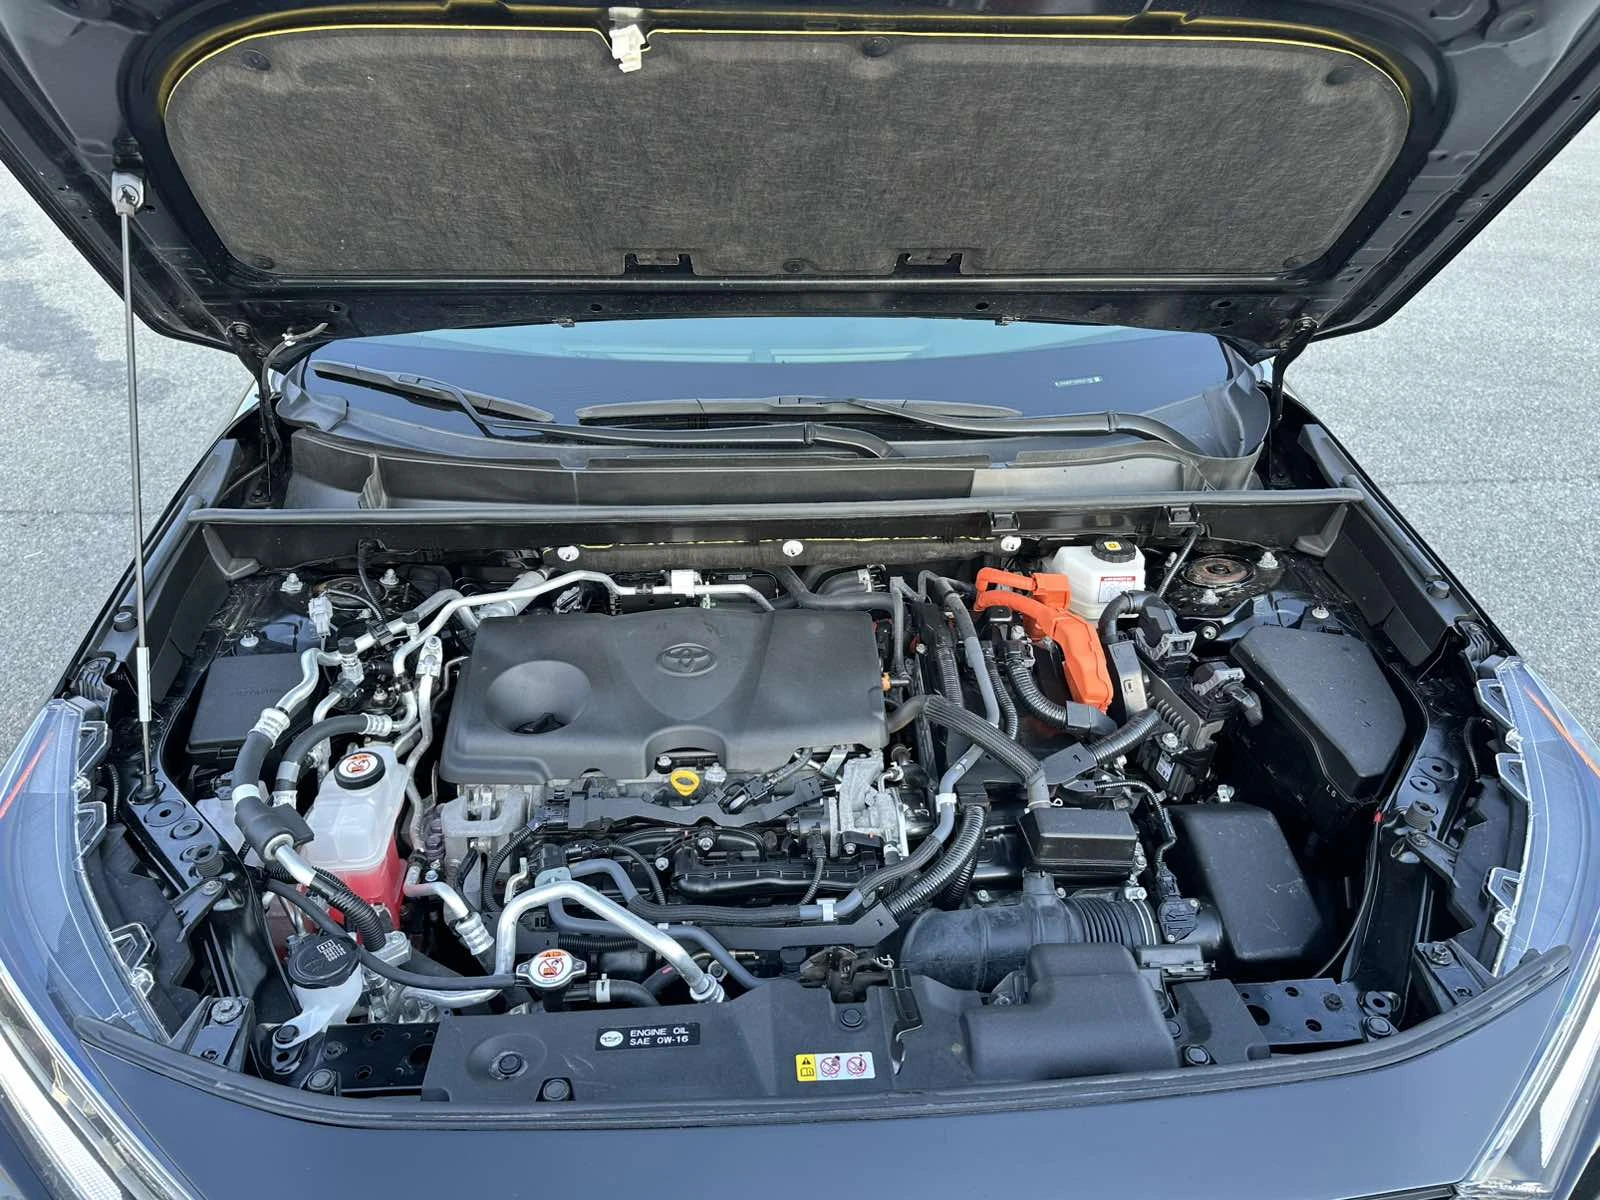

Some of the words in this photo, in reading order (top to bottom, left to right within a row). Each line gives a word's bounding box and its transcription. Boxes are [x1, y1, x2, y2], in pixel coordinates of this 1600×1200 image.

[630, 1028, 667, 1037] ENGINE
[673, 1027, 689, 1035] OIL
[629, 1038, 650, 1046] SAE
[656, 1035, 689, 1044] 0W-16
